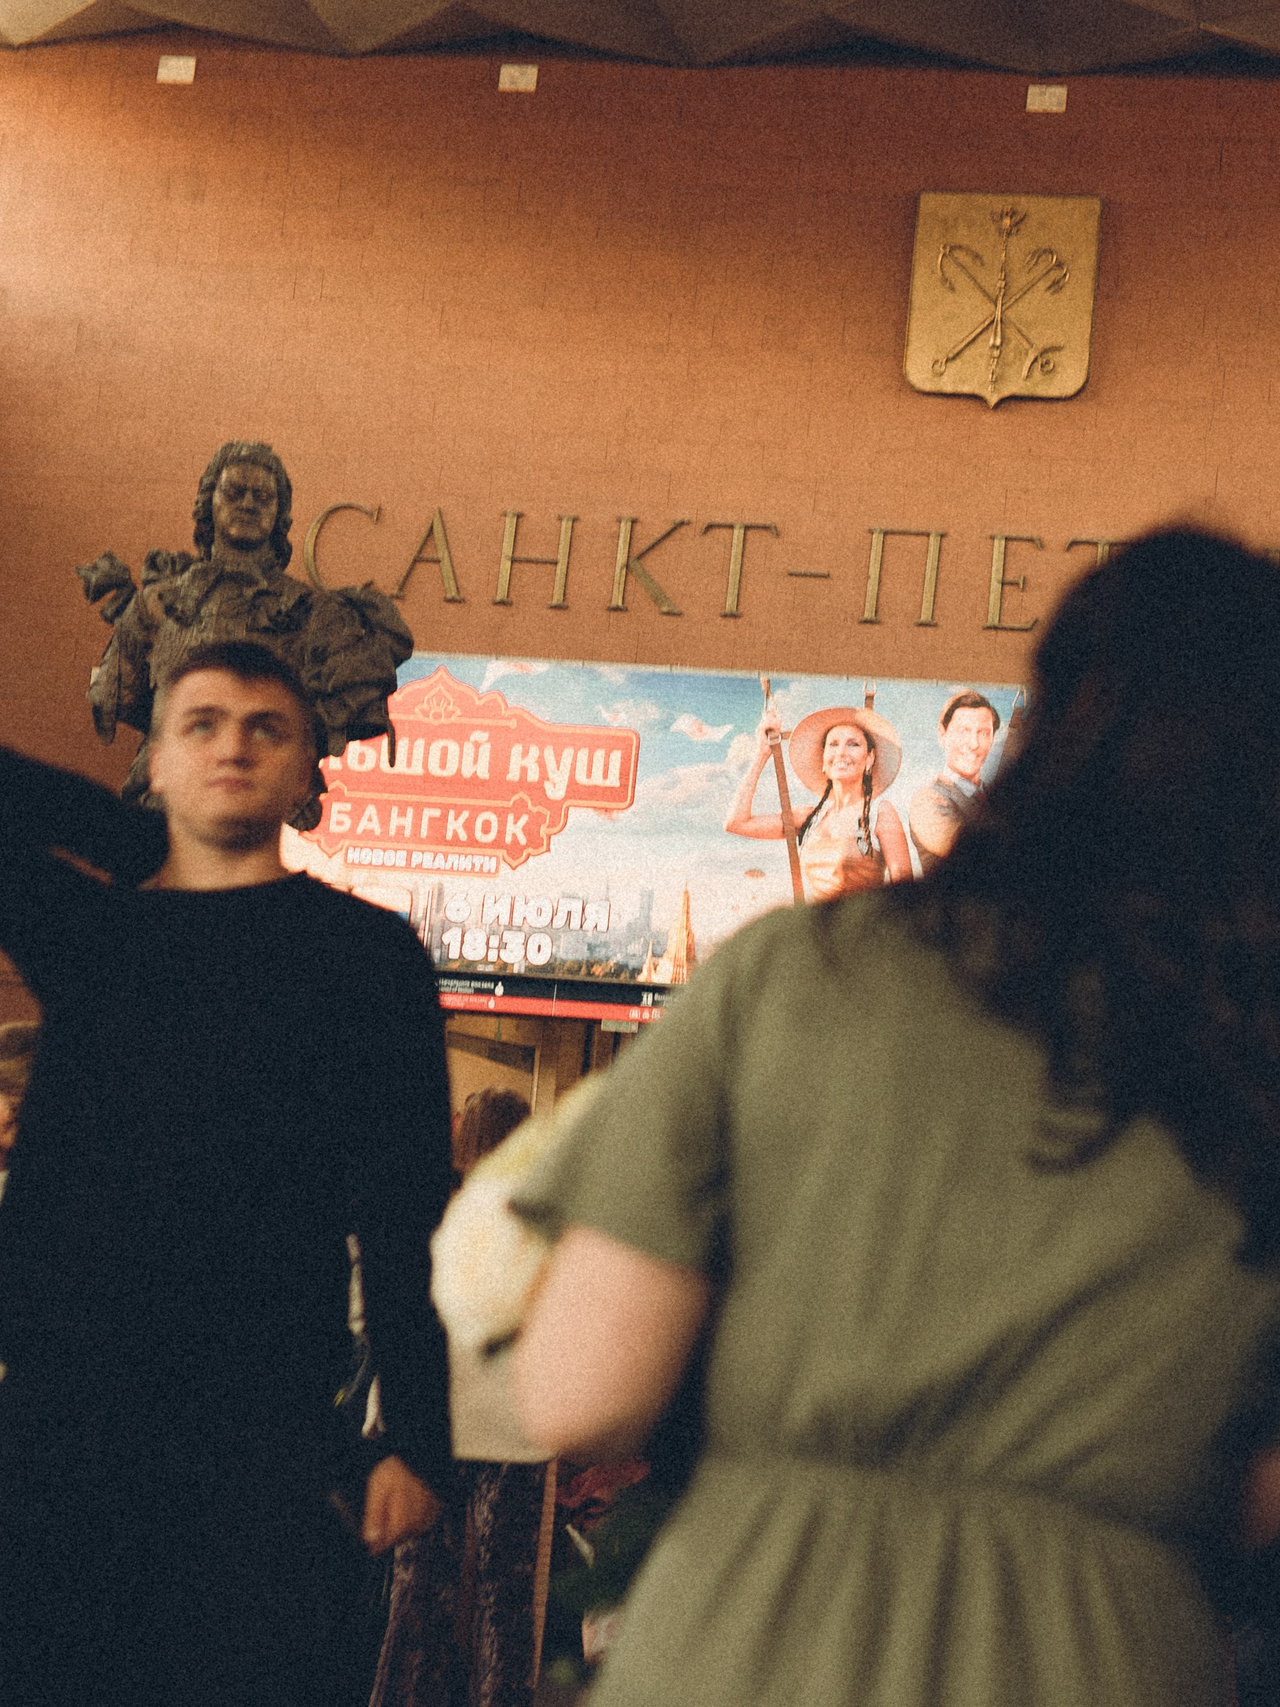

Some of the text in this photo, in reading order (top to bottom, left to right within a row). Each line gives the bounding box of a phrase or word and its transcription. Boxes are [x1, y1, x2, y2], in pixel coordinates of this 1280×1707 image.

[329, 802, 529, 845] БАНГКОК
[347, 846, 498, 874] НОВОЕ РЕАЛИТИ
[445, 892, 612, 933] 6 ИЮЛЯ
[441, 927, 554, 967] 18:30
